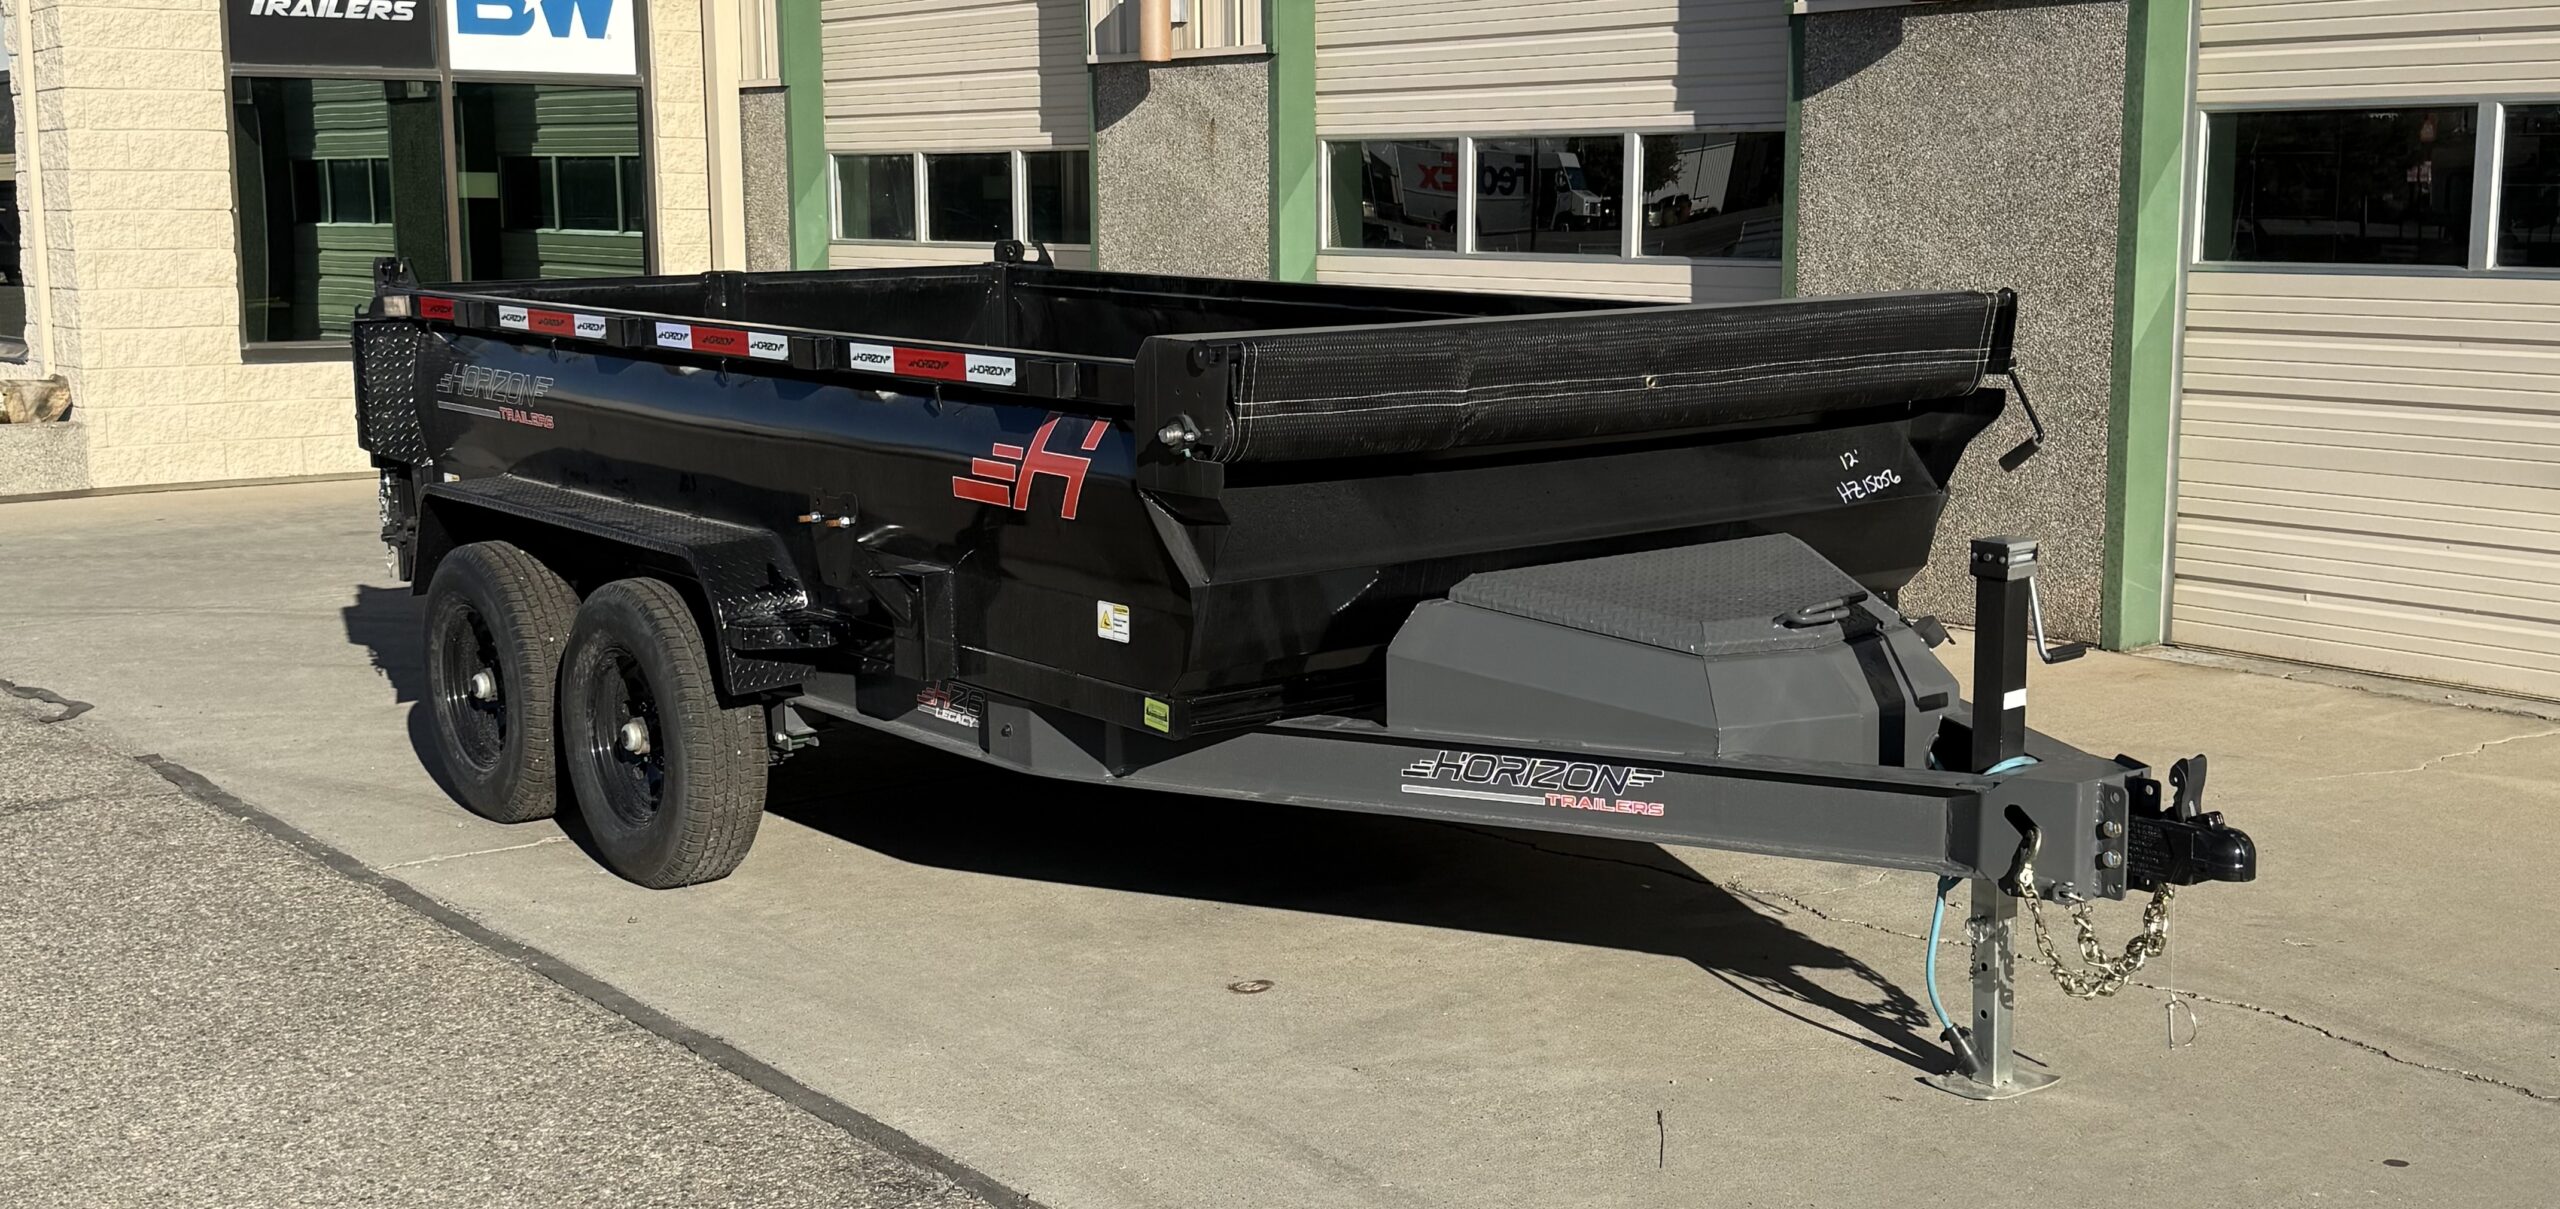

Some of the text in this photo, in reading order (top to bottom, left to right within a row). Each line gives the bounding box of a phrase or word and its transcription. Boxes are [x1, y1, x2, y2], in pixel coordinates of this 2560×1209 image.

[249, 0, 417, 22] TRAILERS
[750, 340, 785, 352] HORIZON
[852, 352, 1013, 377] HORIZON HORIZON HORIZON
[436, 362, 555, 408] HORIZON
[499, 406, 555, 429] TRAILERS
[935, 707, 978, 728] LEGACY
[1402, 751, 1665, 796] HORIZON
[1545, 793, 1665, 817] TRAILERS
